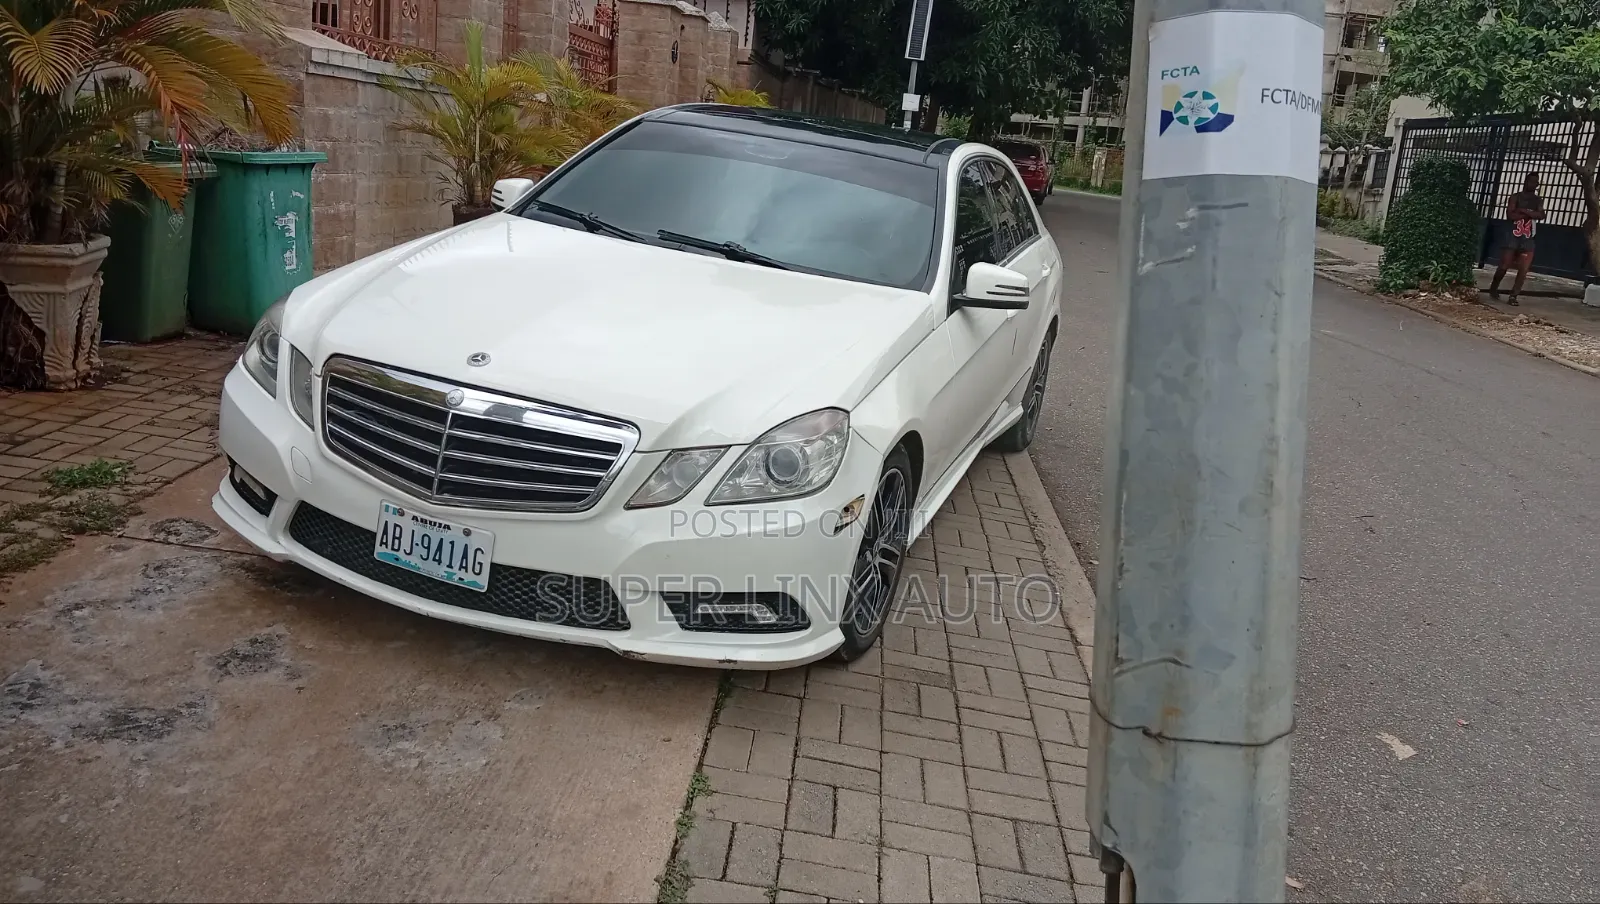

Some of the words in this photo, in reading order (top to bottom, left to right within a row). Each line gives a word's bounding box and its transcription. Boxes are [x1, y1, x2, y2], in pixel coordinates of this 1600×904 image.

[1161, 65, 1200, 80] FCTA
[1260, 87, 1322, 115] FCTA/DFM
[1513, 218, 1531, 238] 34
[411, 515, 452, 531] ABUJA
[379, 520, 485, 576] ABJ-941AG
